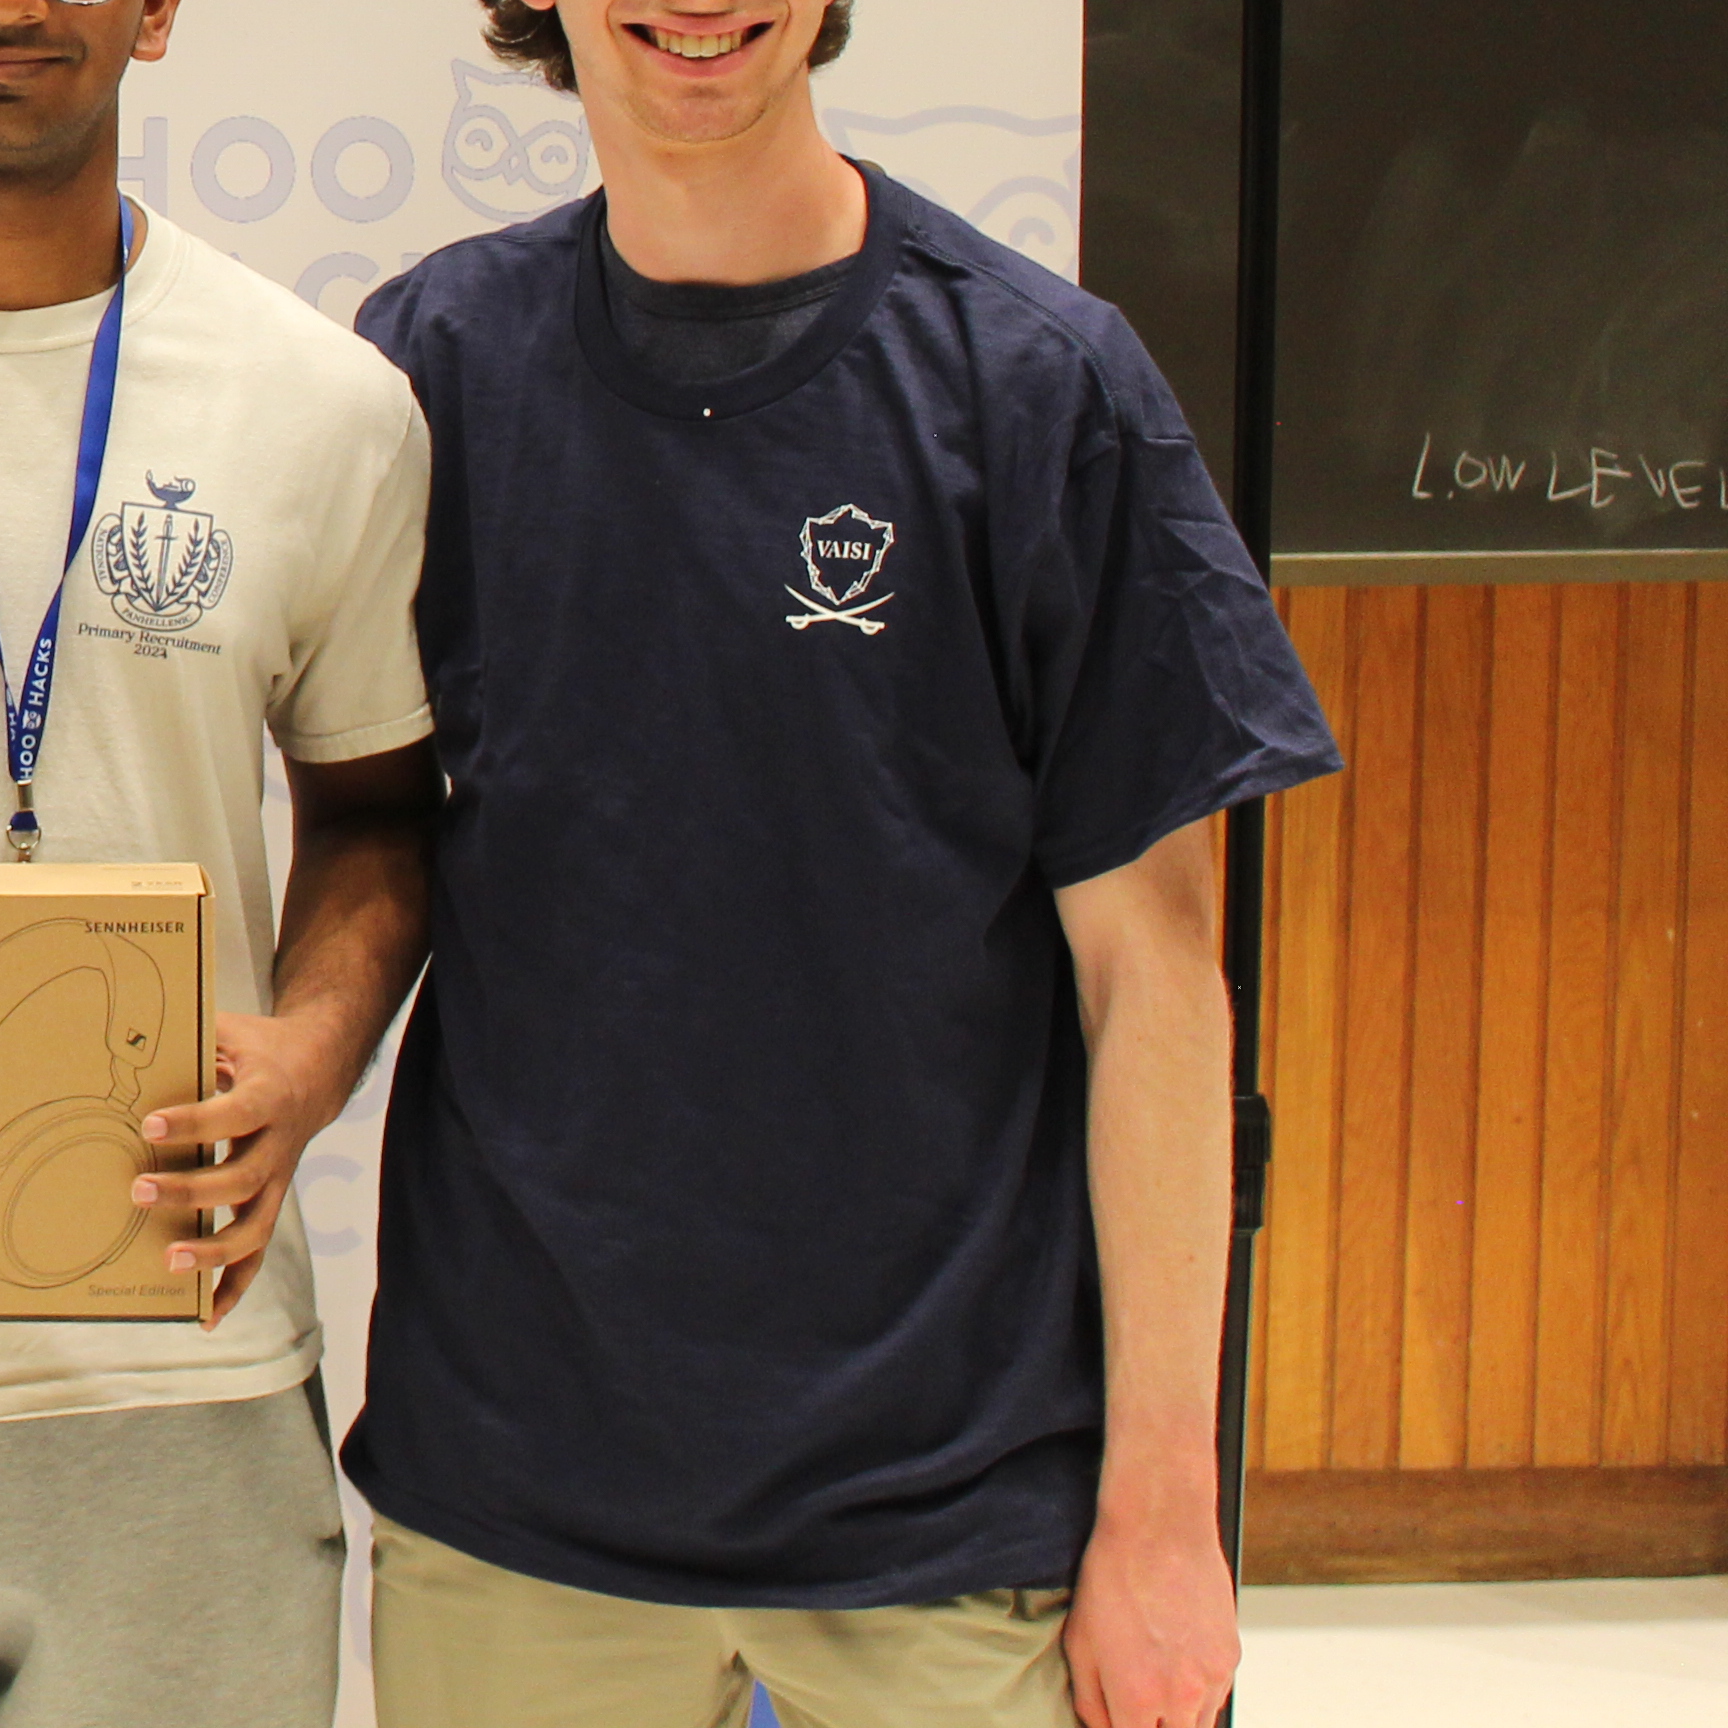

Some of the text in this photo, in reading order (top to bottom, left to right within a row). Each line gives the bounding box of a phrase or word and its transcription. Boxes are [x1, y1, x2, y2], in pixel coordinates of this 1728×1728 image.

[97, 528, 107, 582] NATIONAL
[817, 539, 872, 560] VAISI
[121, 607, 193, 628] PANHELLENIC
[78, 622, 222, 655] Primary Recruitment
[28, 638, 52, 706] HACKS
[84, 922, 185, 934] SENNHEISER
[88, 1283, 186, 1300] Special Edition
